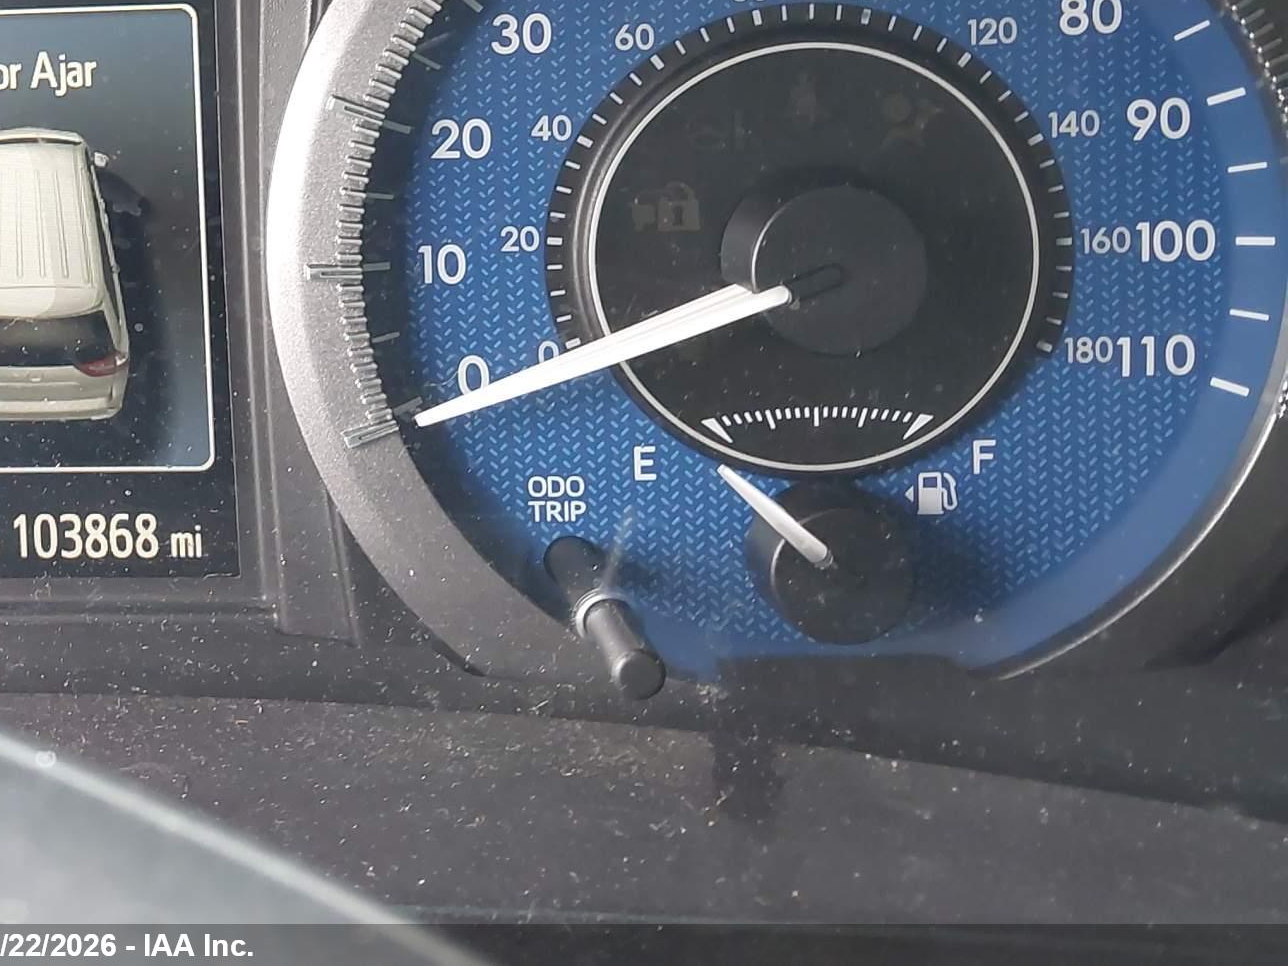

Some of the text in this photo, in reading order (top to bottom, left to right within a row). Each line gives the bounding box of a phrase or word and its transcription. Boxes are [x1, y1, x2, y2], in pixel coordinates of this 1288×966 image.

[491, 13, 552, 55] 30
[615, 24, 655, 51] 60
[968, 17, 1017, 46] 120
[31, 50, 97, 96] Ajar
[531, 115, 572, 142] 40
[1049, 109, 1099, 137] 140
[1126, 98, 1190, 140] 90
[431, 119, 492, 160] 20
[500, 226, 539, 252] 20
[1081, 227, 1130, 254] 160
[1136, 219, 1216, 262] 100
[417, 243, 466, 284] 10
[1064, 336, 1112, 363] 180
[1117, 335, 1195, 376] 110
[457, 355, 489, 395] 0
[634, 446, 656, 481] E
[973, 439, 997, 474] F
[528, 476, 585, 498] ODO
[528, 501, 586, 522] TRIP
[13, 514, 159, 559] 103868
[171, 525, 203, 558] mi
